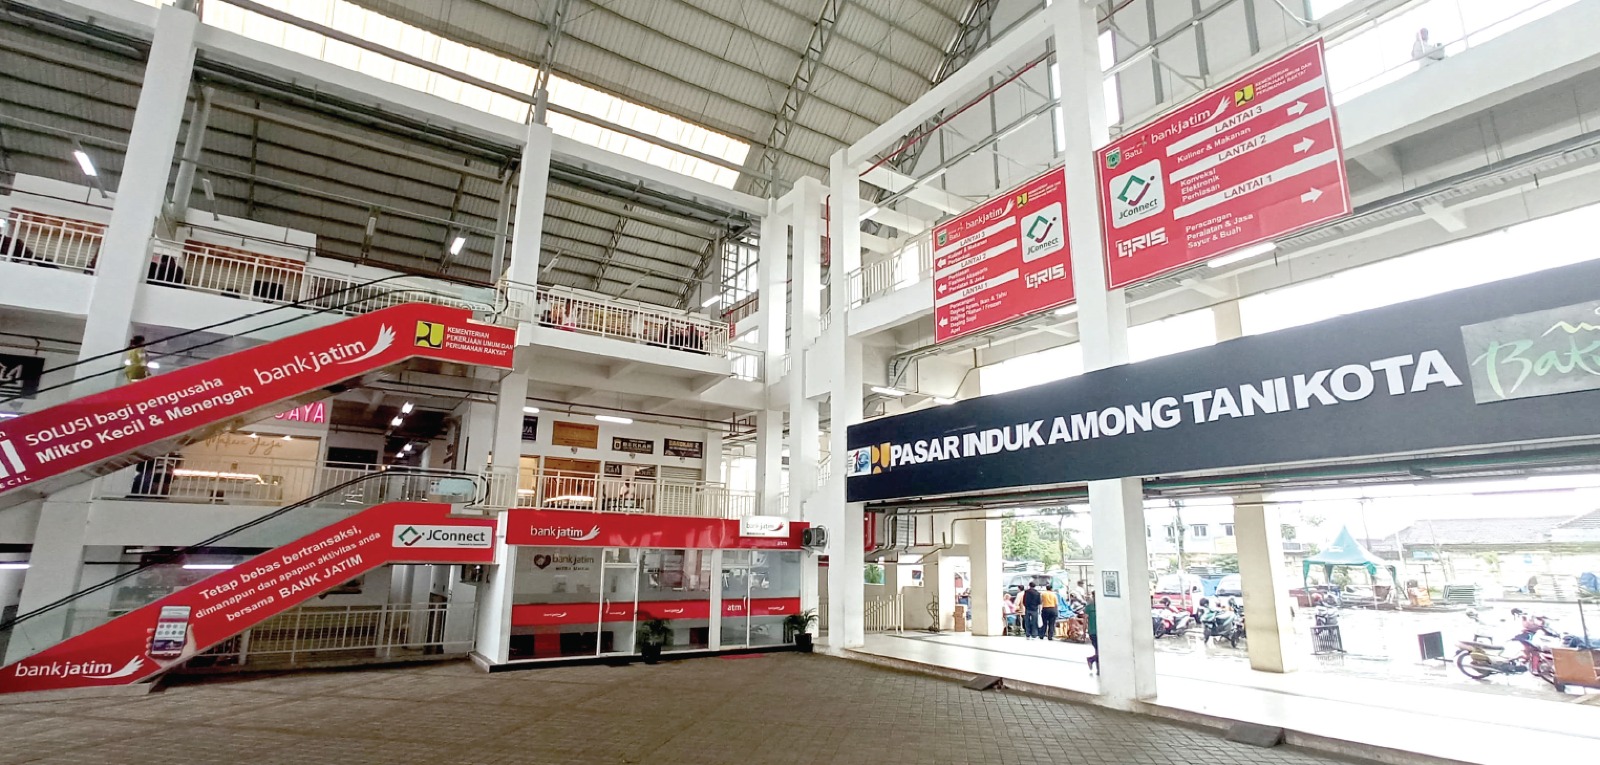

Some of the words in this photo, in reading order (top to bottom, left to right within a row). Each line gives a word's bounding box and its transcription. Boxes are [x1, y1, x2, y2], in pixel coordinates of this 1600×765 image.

[1215, 111, 1252, 133] LANTAI
[1256, 104, 1262, 114] 3
[1124, 148, 1143, 160] Batu
[1177, 149, 1204, 163] Kuliner
[1214, 126, 1251, 147] Makanan
[1218, 139, 1258, 162] LANTAI
[1260, 134, 1266, 144] 2
[1180, 168, 1216, 187] Konveksi
[1182, 175, 1220, 195] Elektronik
[1224, 178, 1263, 199] LANTAI
[1268, 174, 1273, 183] 1
[1182, 184, 1220, 202] Perhiasan
[1118, 198, 1158, 220] JConnect
[1234, 213, 1254, 225] Jasa
[1186, 212, 1232, 232] Peracangan
[960, 235, 980, 246] LANTAI
[1027, 238, 1059, 255] JConnect
[1116, 228, 1168, 258] QRIS
[1188, 235, 1211, 249] Sayur
[1220, 226, 1242, 238] Buah
[961, 255, 982, 267] LANTAI
[1024, 263, 1066, 289] QRIS
[962, 284, 983, 296] LANTAI
[446, 334, 482, 345] PEKERJAAN
[483, 340, 500, 348] UMUM
[447, 326, 489, 339] KEMENTERIAN
[446, 342, 483, 352] PERUMAHAN
[484, 347, 506, 356] RAKYAT
[25, 416, 92, 446] SOLUSI
[95, 404, 134, 424] bagi
[136, 377, 223, 414] pengusaha
[274, 402, 325, 423] AYA
[890, 436, 959, 467] PASAR
[963, 420, 1046, 457] INDUK
[1048, 397, 1180, 445] AMONG
[1183, 376, 1290, 424] TANI
[1293, 349, 1463, 409] KOTA
[35, 439, 93, 464] Mikro
[96, 420, 145, 444] Kecil
[149, 413, 164, 427] &
[166, 385, 253, 422] Menengah
[426, 530, 485, 541] JConnect
[199, 579, 238, 599] Tetap
[240, 562, 280, 583] bebas
[282, 526, 362, 564] bertransaksi,
[195, 588, 255, 619] dimanapun
[258, 578, 277, 591] dan
[279, 560, 316, 582] apapun
[318, 542, 356, 564] aktivitas
[359, 532, 381, 546] anda
[226, 596, 274, 622] bersama
[279, 573, 321, 599] BANK
[323, 554, 363, 578] JATIM
